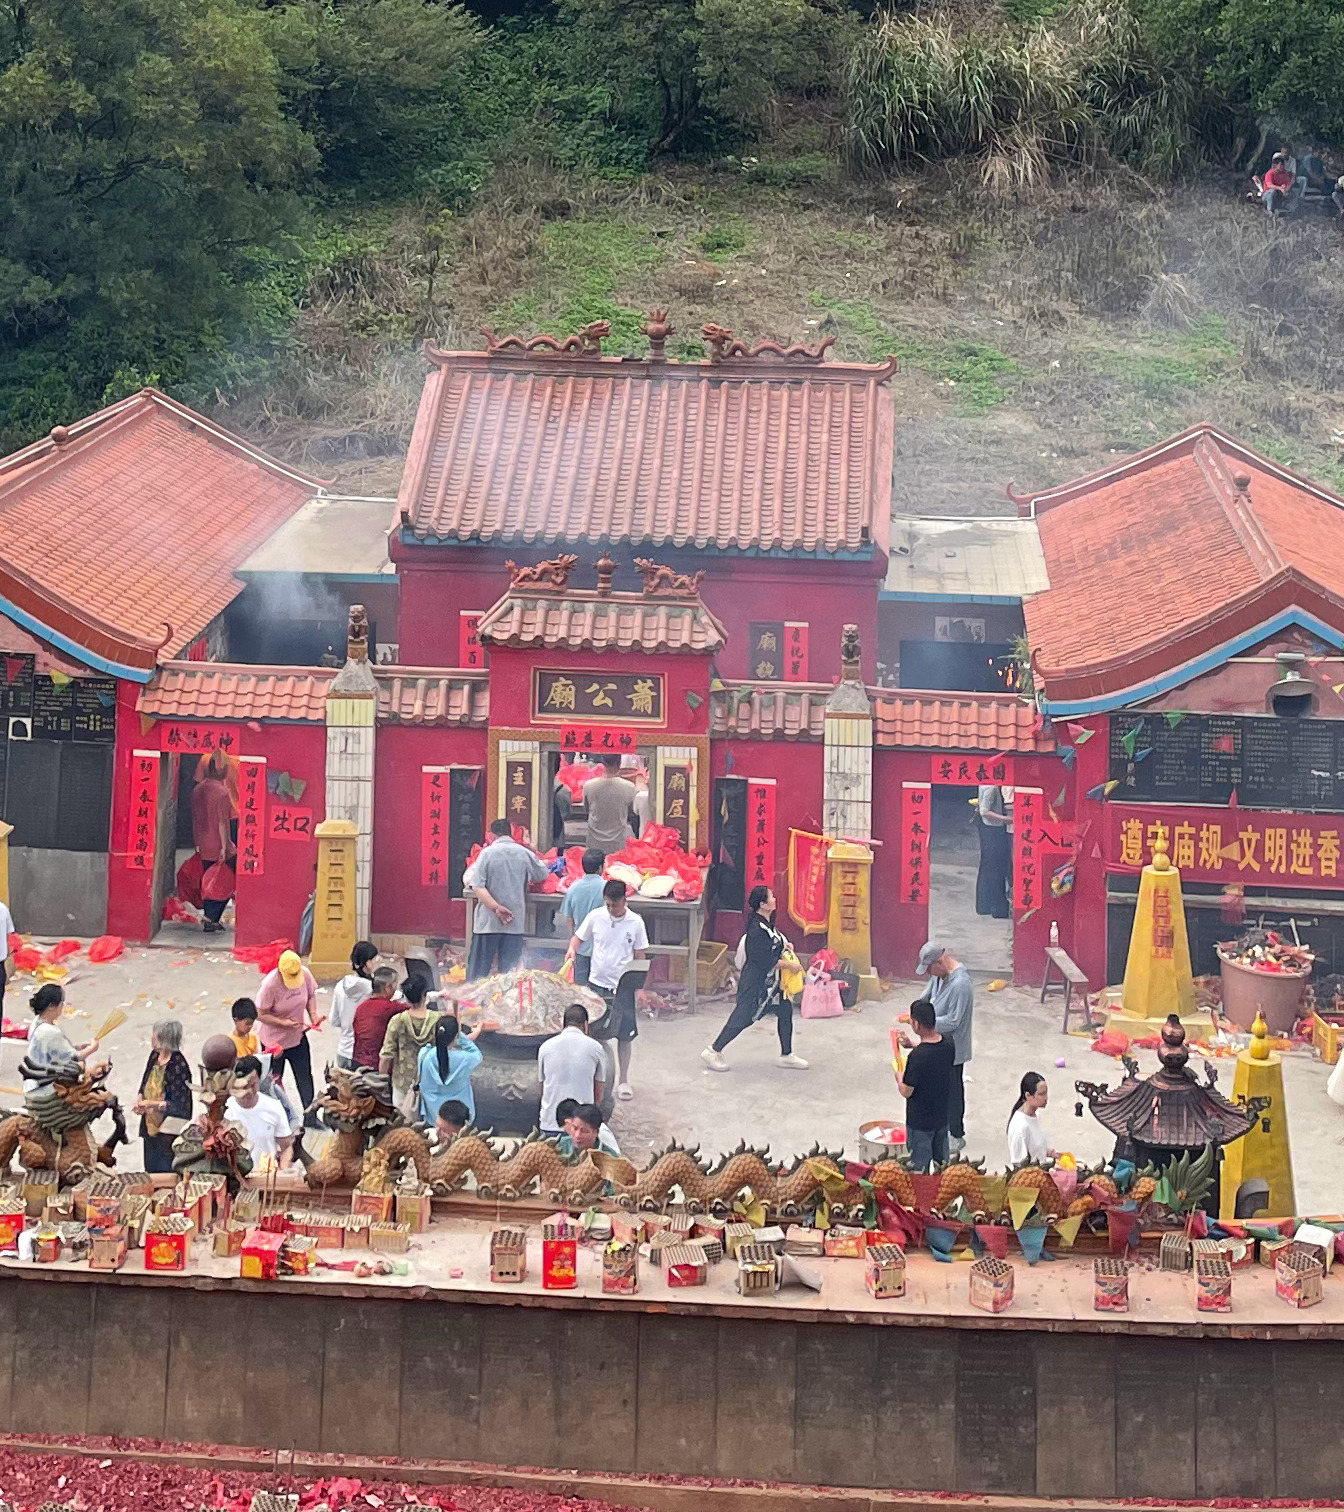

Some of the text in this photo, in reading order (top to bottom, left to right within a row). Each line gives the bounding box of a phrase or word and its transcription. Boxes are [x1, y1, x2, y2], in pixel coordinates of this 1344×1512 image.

[273, 809, 310, 833] 出口
[1237, 824, 1341, 878] 文明进香
